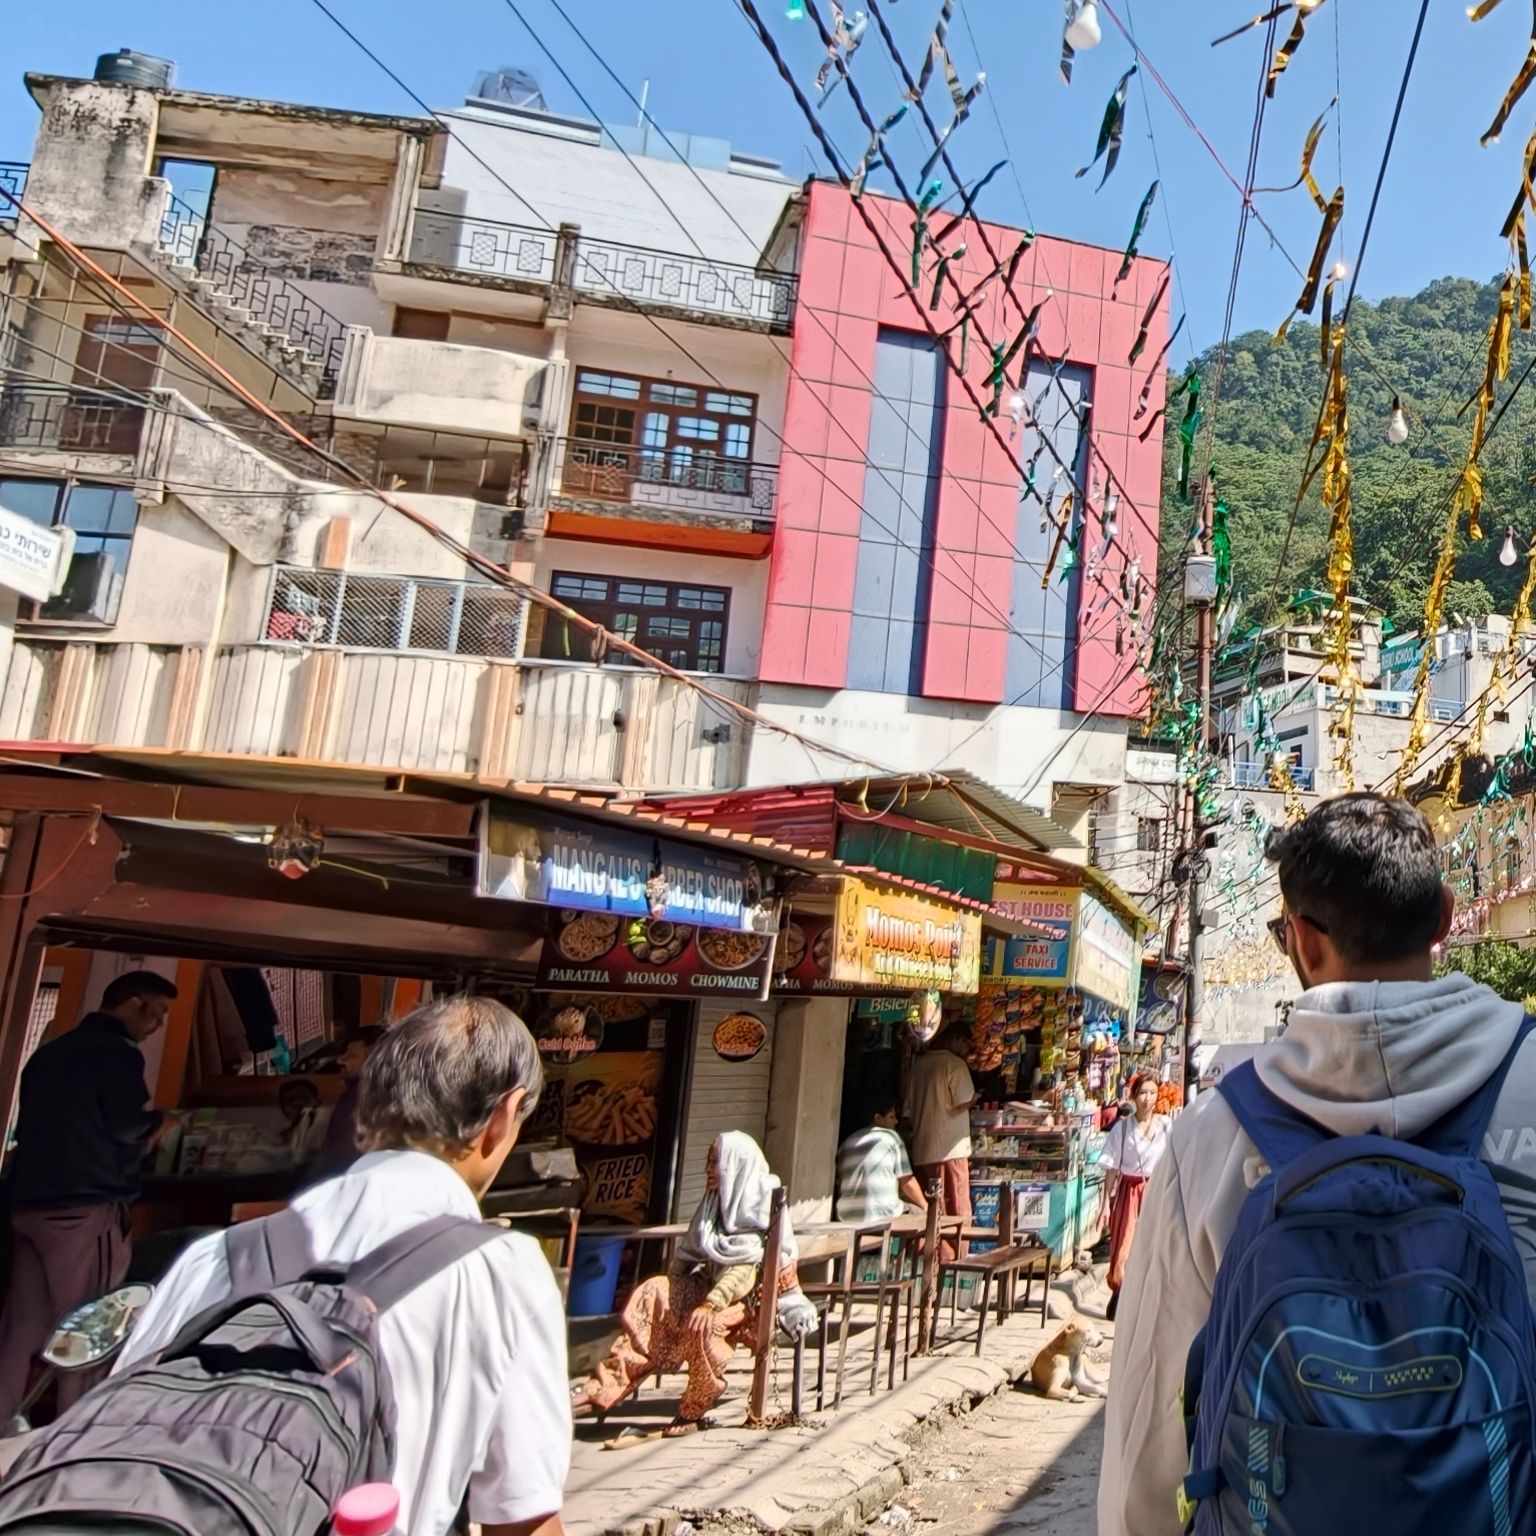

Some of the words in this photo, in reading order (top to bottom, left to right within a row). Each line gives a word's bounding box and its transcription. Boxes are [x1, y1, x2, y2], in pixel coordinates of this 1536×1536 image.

[550, 844, 643, 902] MANGAL'S
[704, 873, 744, 918] SHOP
[1022, 901, 1073, 920] HOUSE
[865, 905, 921, 956] Momos
[1025, 944, 1050, 955] TAXI
[1013, 956, 1057, 969] SERVICE
[548, 967, 611, 984] PARATHA
[623, 970, 679, 987] MOMOS
[690, 973, 761, 991] CHOWMINE
[812, 978, 854, 991] MOMOS
[594, 1156, 646, 1182] FRIED
[594, 1178, 637, 1204] RICE
